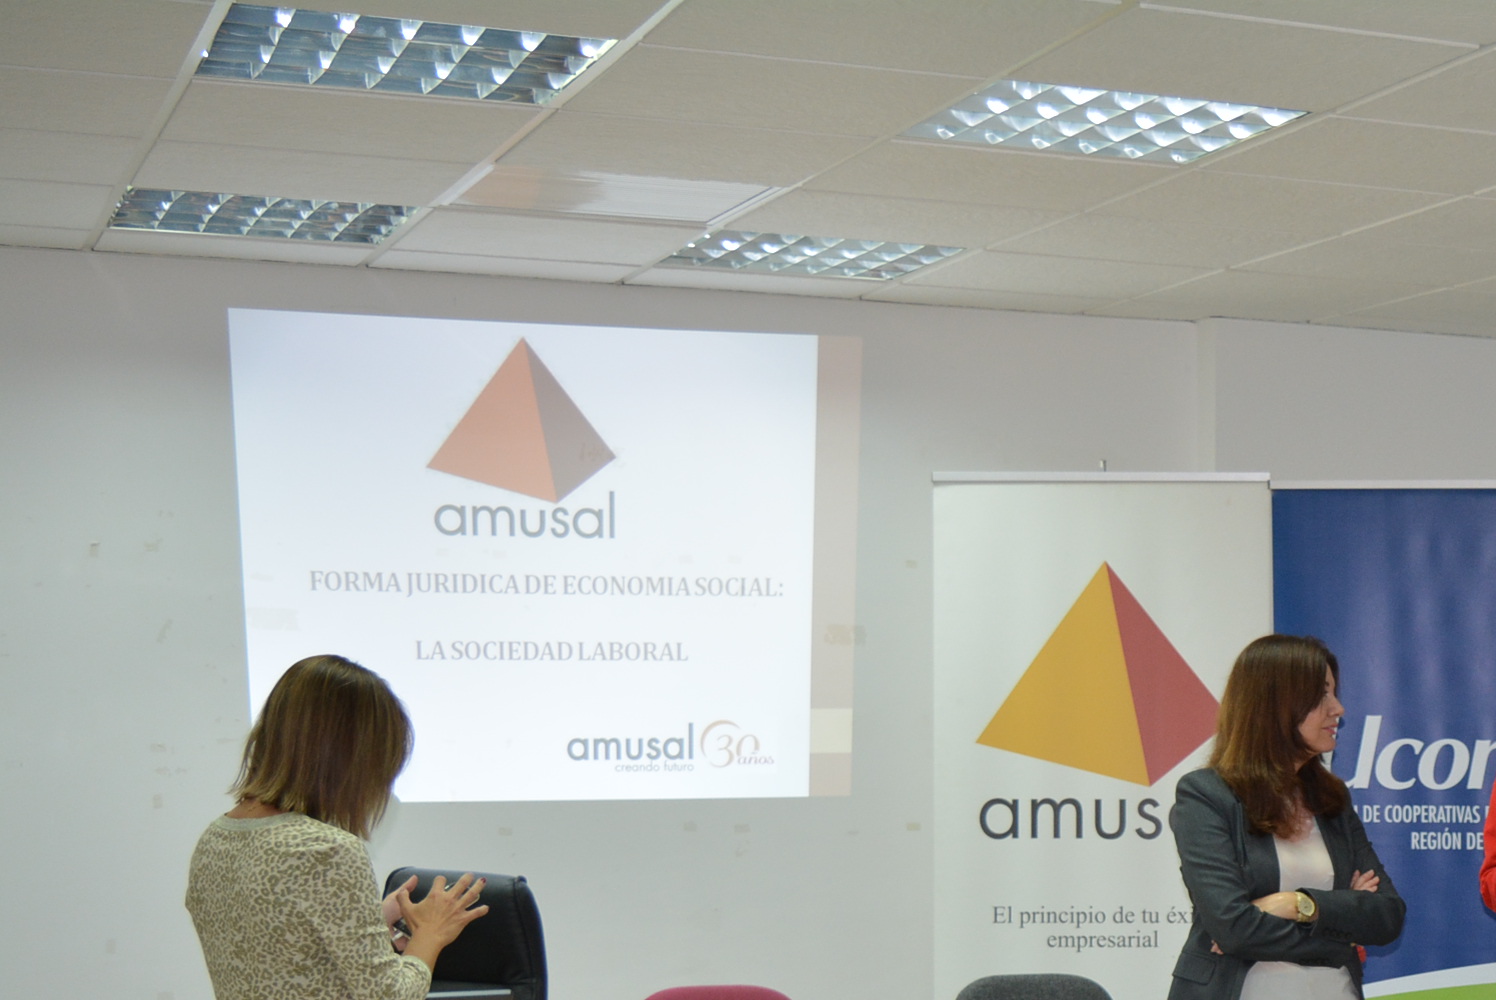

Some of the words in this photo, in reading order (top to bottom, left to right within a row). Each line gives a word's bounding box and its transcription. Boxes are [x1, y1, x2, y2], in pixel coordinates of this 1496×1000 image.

[434, 490, 615, 539] amusal
[310, 570, 401, 593] FORMA
[406, 572, 520, 598] JURIDICA
[524, 574, 557, 595] DE
[562, 575, 692, 596] ECONOMIA
[694, 577, 784, 598] SOCIAL:
[416, 641, 447, 661] LA
[451, 641, 573, 661] SOCIEDAD
[578, 642, 689, 662] LABORAL
[567, 722, 694, 761] amusal
[614, 760, 660, 772] creando
[663, 760, 695, 772] futuro
[737, 753, 775, 766] años
[979, 797, 1176, 840] amus
[1363, 804, 1381, 823] DE
[1384, 804, 1481, 824] COOPERATIVAS
[1411, 827, 1462, 851] REGIÓN
[992, 905, 1012, 925] El
[1019, 905, 1106, 929] principio
[1112, 906, 1135, 925] de
[1142, 908, 1160, 925] tu
[1166, 905, 1196, 925] éxi
[1047, 930, 1159, 952] empresarial
